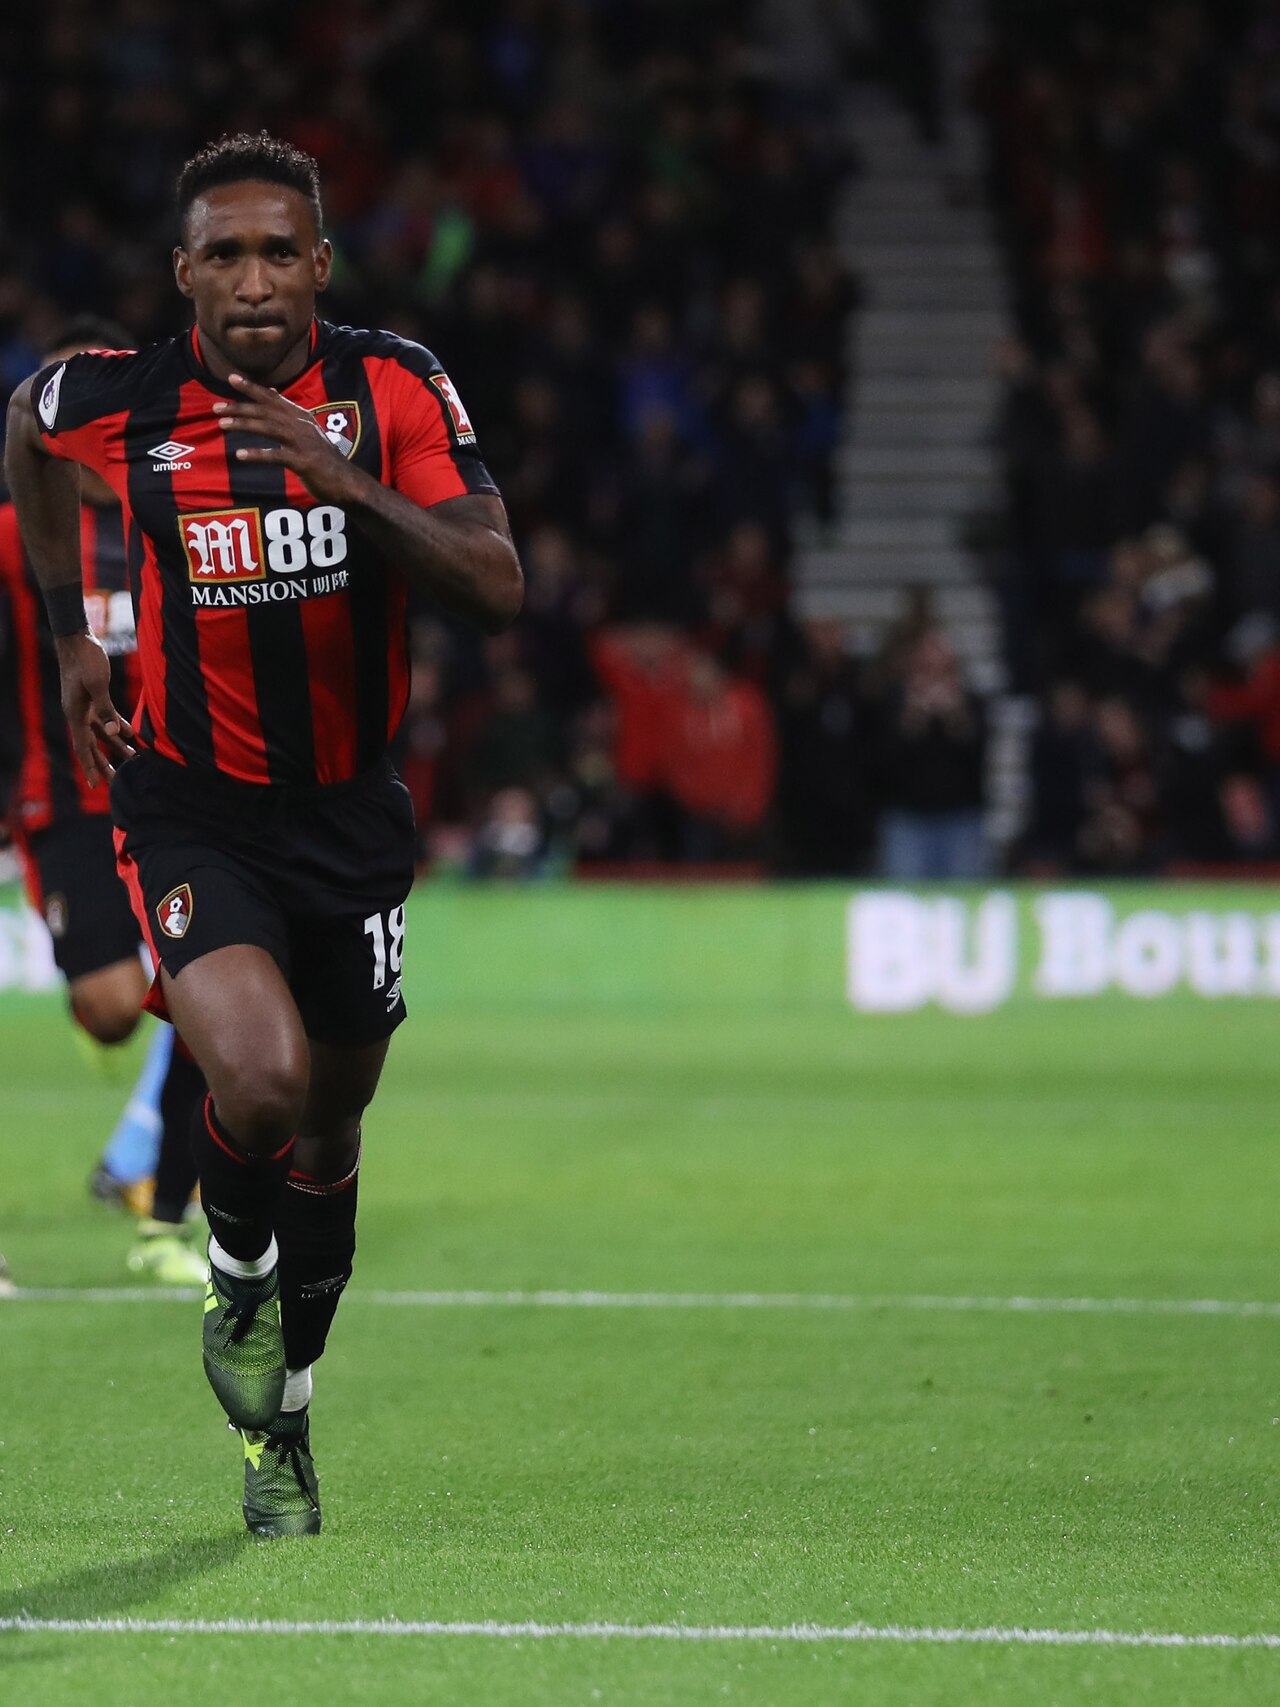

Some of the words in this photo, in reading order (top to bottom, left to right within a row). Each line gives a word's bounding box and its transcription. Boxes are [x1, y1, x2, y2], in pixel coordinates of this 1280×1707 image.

[152, 461, 192, 472] umbro
[190, 578, 308, 607] MANSION
[364, 903, 406, 990] 18
[848, 888, 1020, 1015] BU
